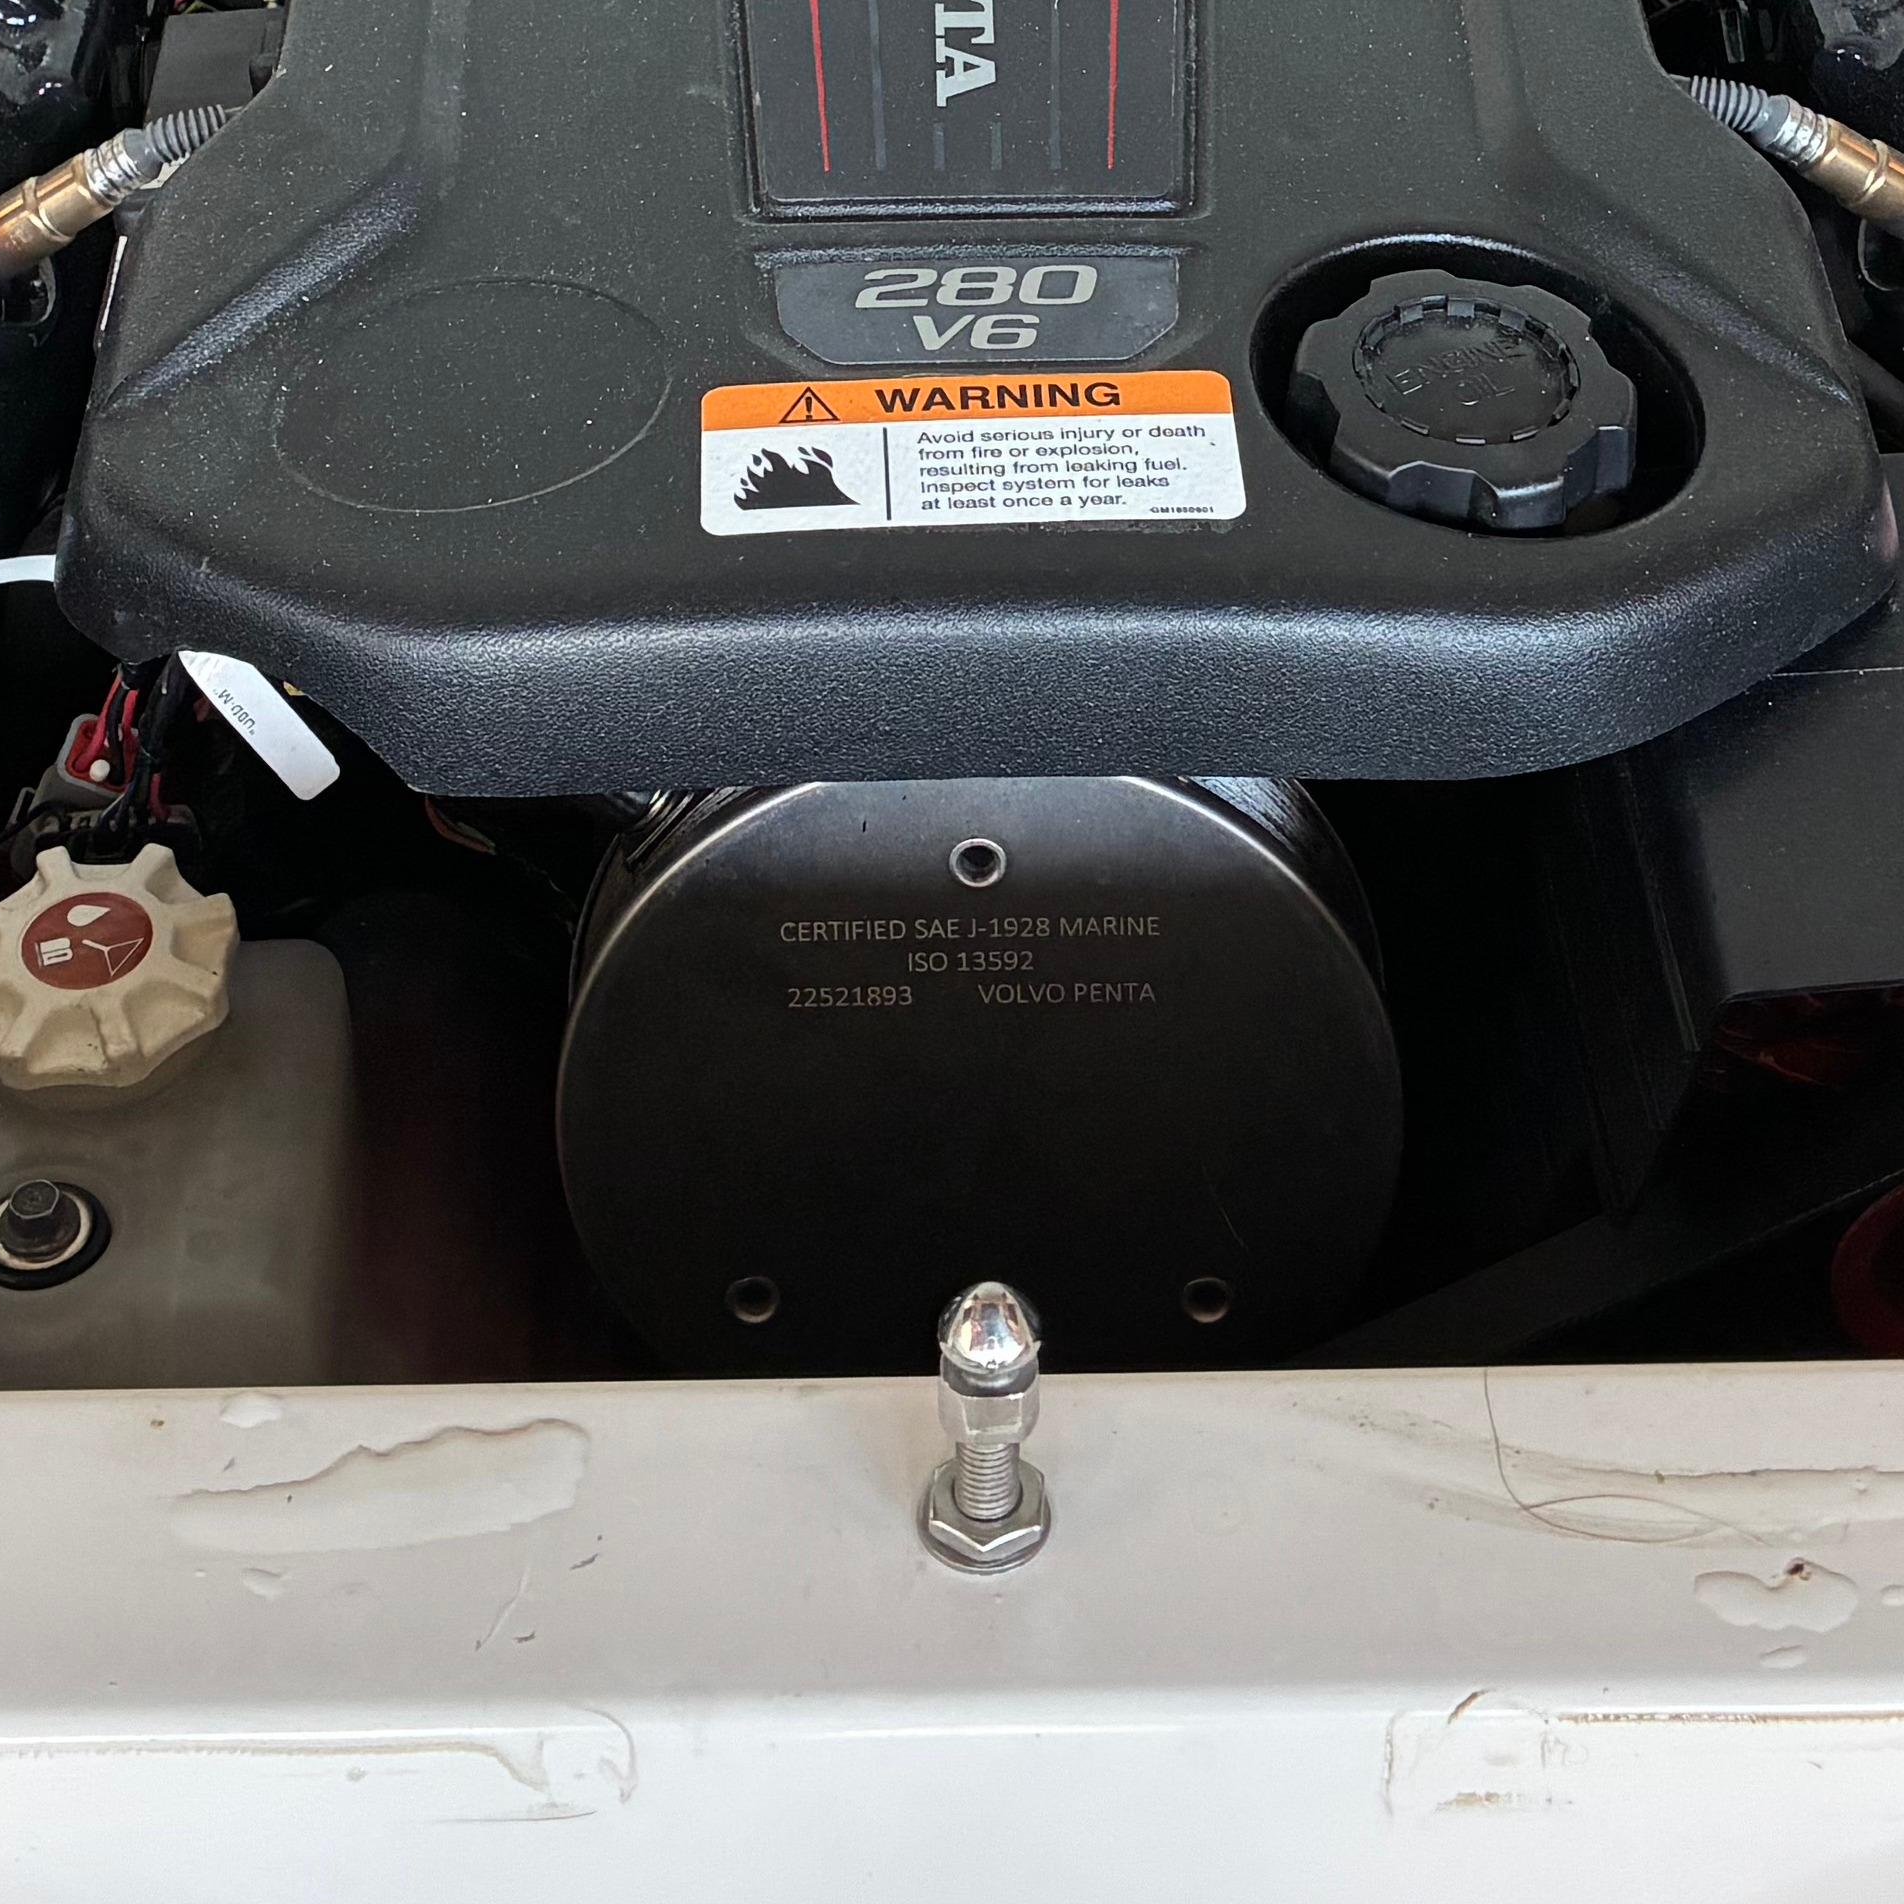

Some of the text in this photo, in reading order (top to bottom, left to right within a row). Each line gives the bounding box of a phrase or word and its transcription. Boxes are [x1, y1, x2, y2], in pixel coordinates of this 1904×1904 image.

[854, 262, 1098, 310] 280
[913, 312, 1040, 352] V6
[1387, 331, 1528, 397] ENGINE
[875, 382, 1121, 415] WARNING
[1457, 371, 1516, 407] OIL
[917, 425, 1206, 445] Avoid serious injury or death
[918, 442, 1139, 461] from fire or explosion,
[919, 457, 1187, 478] resulting from leaking fuel.
[921, 475, 1170, 495] Inspect system for leaks
[921, 493, 1127, 510] at least once a year.
[779, 914, 1162, 944] CERTIFIED SAE J-1928 MARINE
[906, 948, 1035, 975] ISO 13592
[787, 980, 1156, 1009] 22521893 VOLVO PENTA
